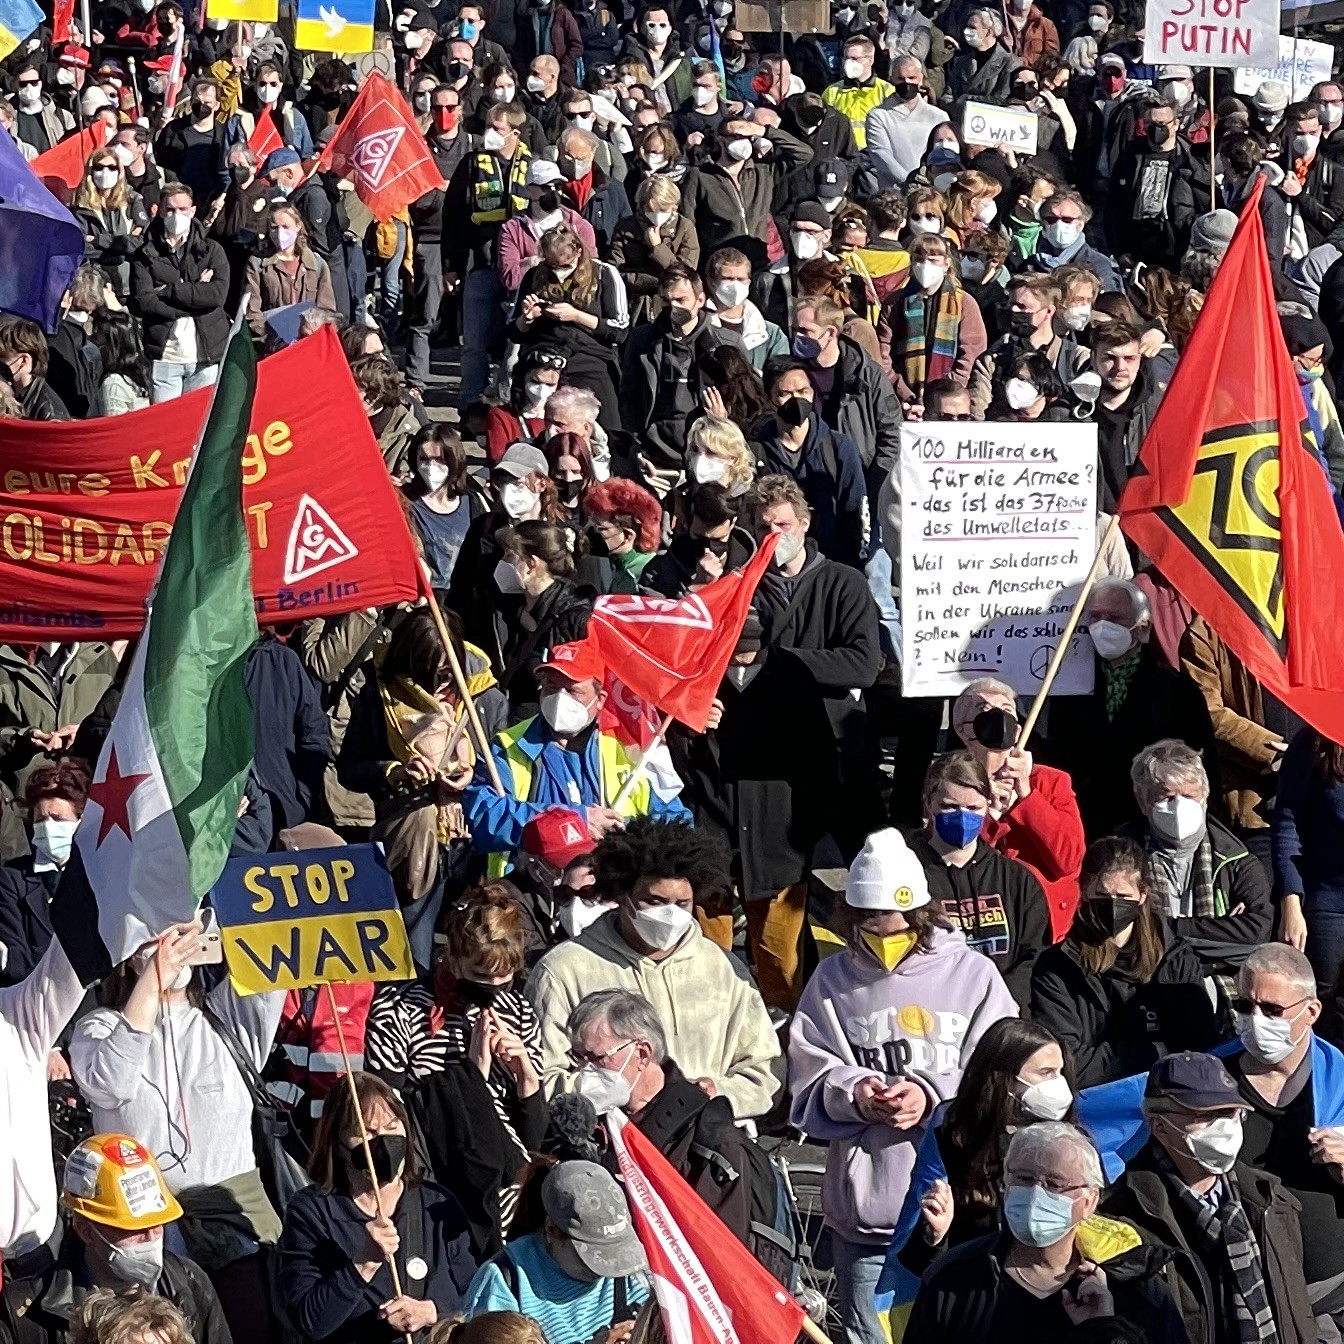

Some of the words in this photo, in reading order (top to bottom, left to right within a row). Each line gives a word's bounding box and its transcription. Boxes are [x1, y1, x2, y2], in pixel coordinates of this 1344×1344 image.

[1162, 21, 1252, 56] PUTIN
[1244, 67, 1316, 86] ENGINERS
[3, 469, 112, 498] eure
[130, 420, 294, 490] Krge
[911, 438, 945, 458] 100
[956, 439, 1058, 462] Milliarden
[928, 466, 969, 491] für
[974, 468, 1005, 488] die
[962, 491, 988, 512] ist
[996, 493, 1026, 512] das
[923, 519, 953, 537] des
[911, 553, 943, 572] Weil
[957, 553, 985, 570] wir
[989, 549, 1079, 570] solidarisch
[276, 579, 360, 614] Berlin
[915, 581, 942, 597] mit
[952, 581, 981, 597] den
[987, 576, 1066, 595] Menschen
[916, 604, 936, 622] in
[943, 604, 971, 619] der
[980, 603, 1044, 620] Ukraine
[1048, 598, 1076, 615] sin
[913, 625, 960, 643] sollen
[969, 624, 996, 640] wir
[1004, 624, 1028, 640] das
[943, 649, 987, 664] Nein
[243, 859, 356, 913] STOP
[234, 918, 398, 984] WAR
